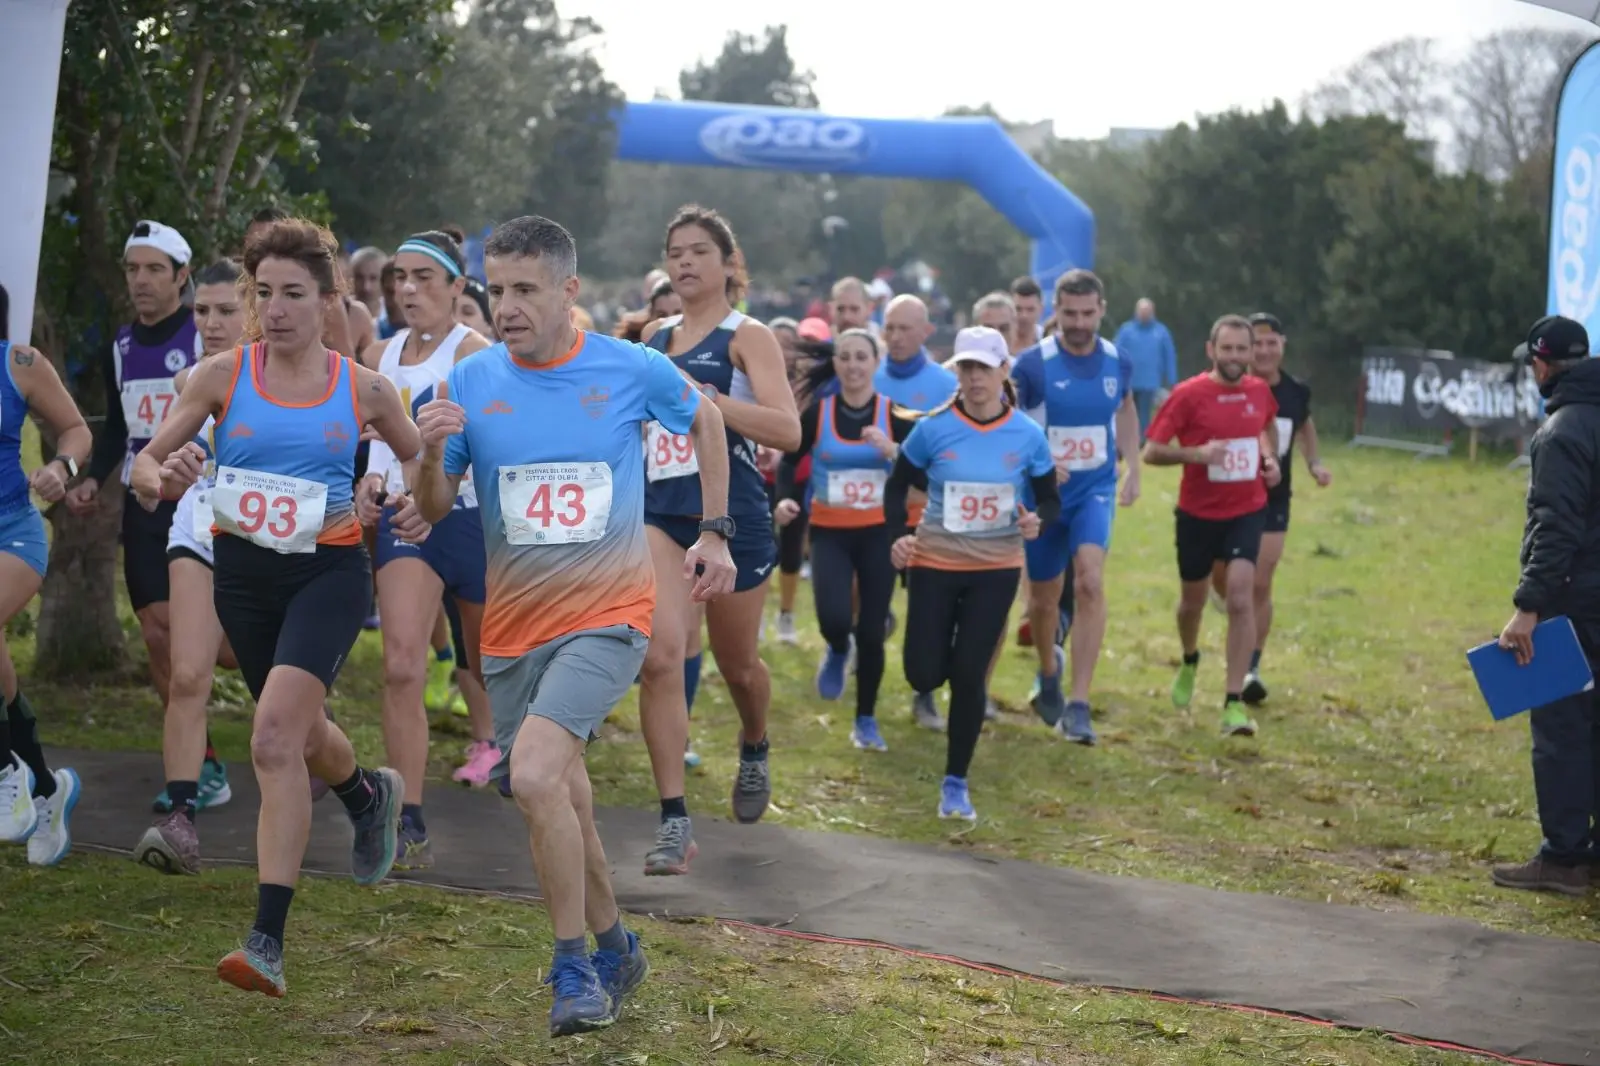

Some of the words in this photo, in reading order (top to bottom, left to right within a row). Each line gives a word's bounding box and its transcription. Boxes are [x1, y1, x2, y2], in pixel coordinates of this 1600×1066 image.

[138, 394, 174, 425] 47
[655, 433, 693, 467] 89
[1062, 437, 1095, 461] 29
[244, 475, 267, 484] FESTIVAL
[843, 482, 876, 504] 92
[237, 491, 298, 538] 93
[526, 483, 587, 528] 43
[960, 495, 1000, 521] 95
